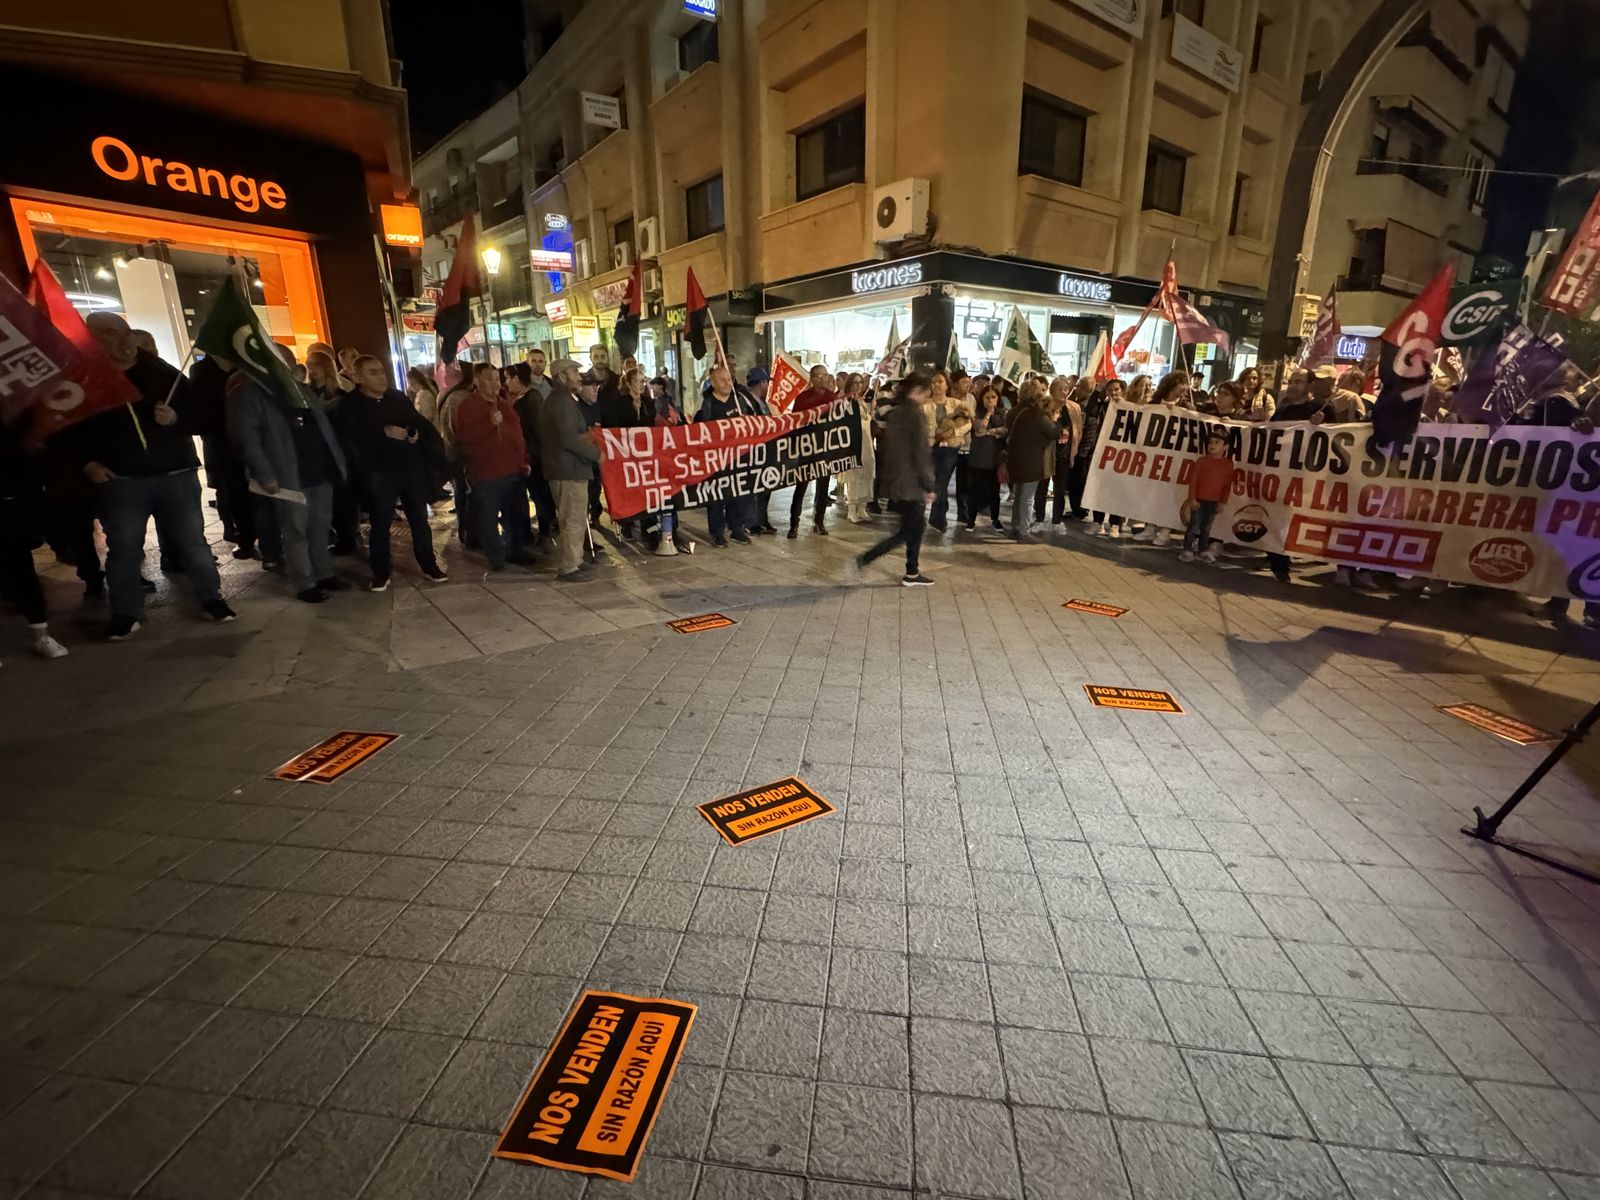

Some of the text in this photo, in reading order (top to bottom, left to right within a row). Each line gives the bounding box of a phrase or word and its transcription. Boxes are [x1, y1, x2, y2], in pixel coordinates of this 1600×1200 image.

[91, 136, 287, 213] Orange
[387, 233, 420, 244] orange
[666, 307, 686, 328] yoig
[772, 371, 801, 407] PSOE
[602, 426, 654, 460] NO
[662, 427, 677, 451] A
[684, 421, 713, 446] LA
[622, 459, 669, 489] DEL
[776, 425, 852, 463] PUBLICO
[1109, 409, 1600, 492] EN DEFENA DE LOS SERVICIOS
[645, 485, 675, 514] DE
[1098, 445, 1146, 477] POR
[1149, 455, 1174, 482] EL
[1176, 458, 1281, 503] DCHO
[1283, 477, 1304, 508] A
[1310, 479, 1349, 514] LA
[1357, 483, 1538, 533] CARRERA
[1238, 522, 1262, 535] CGT
[1295, 522, 1430, 563] CCOO
[1477, 542, 1527, 564] UGT
[1093, 687, 1167, 700] NOS VENDEN
[712, 783, 802, 818] NOS VENDEN
[736, 821, 756, 831] SIN
[527, 1005, 626, 1145] NOS VENDEN
[596, 1020, 665, 1143] SIN RAZÓN AQUÍ
